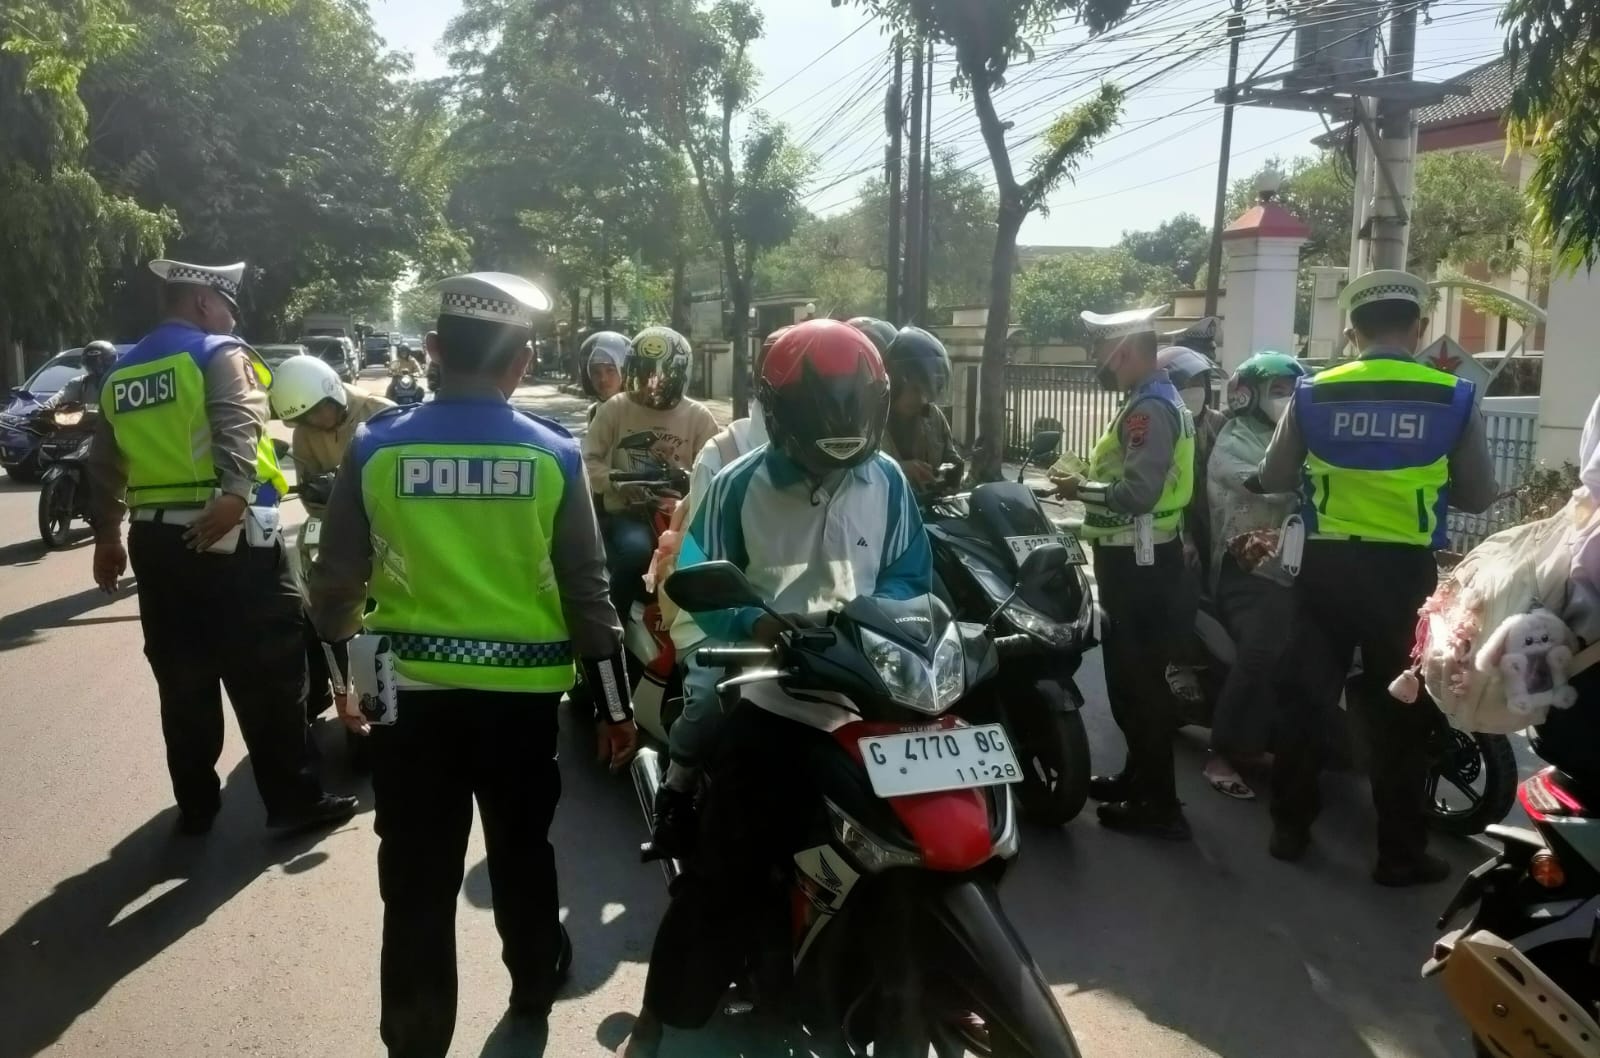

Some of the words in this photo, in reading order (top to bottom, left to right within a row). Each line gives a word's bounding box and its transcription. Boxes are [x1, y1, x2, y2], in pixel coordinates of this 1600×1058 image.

[114, 371, 174, 411] POLISI
[1333, 412, 1425, 439] POLISI
[403, 459, 532, 495] POLISI
[869, 742, 887, 765] G
[904, 734, 961, 761] 4770
